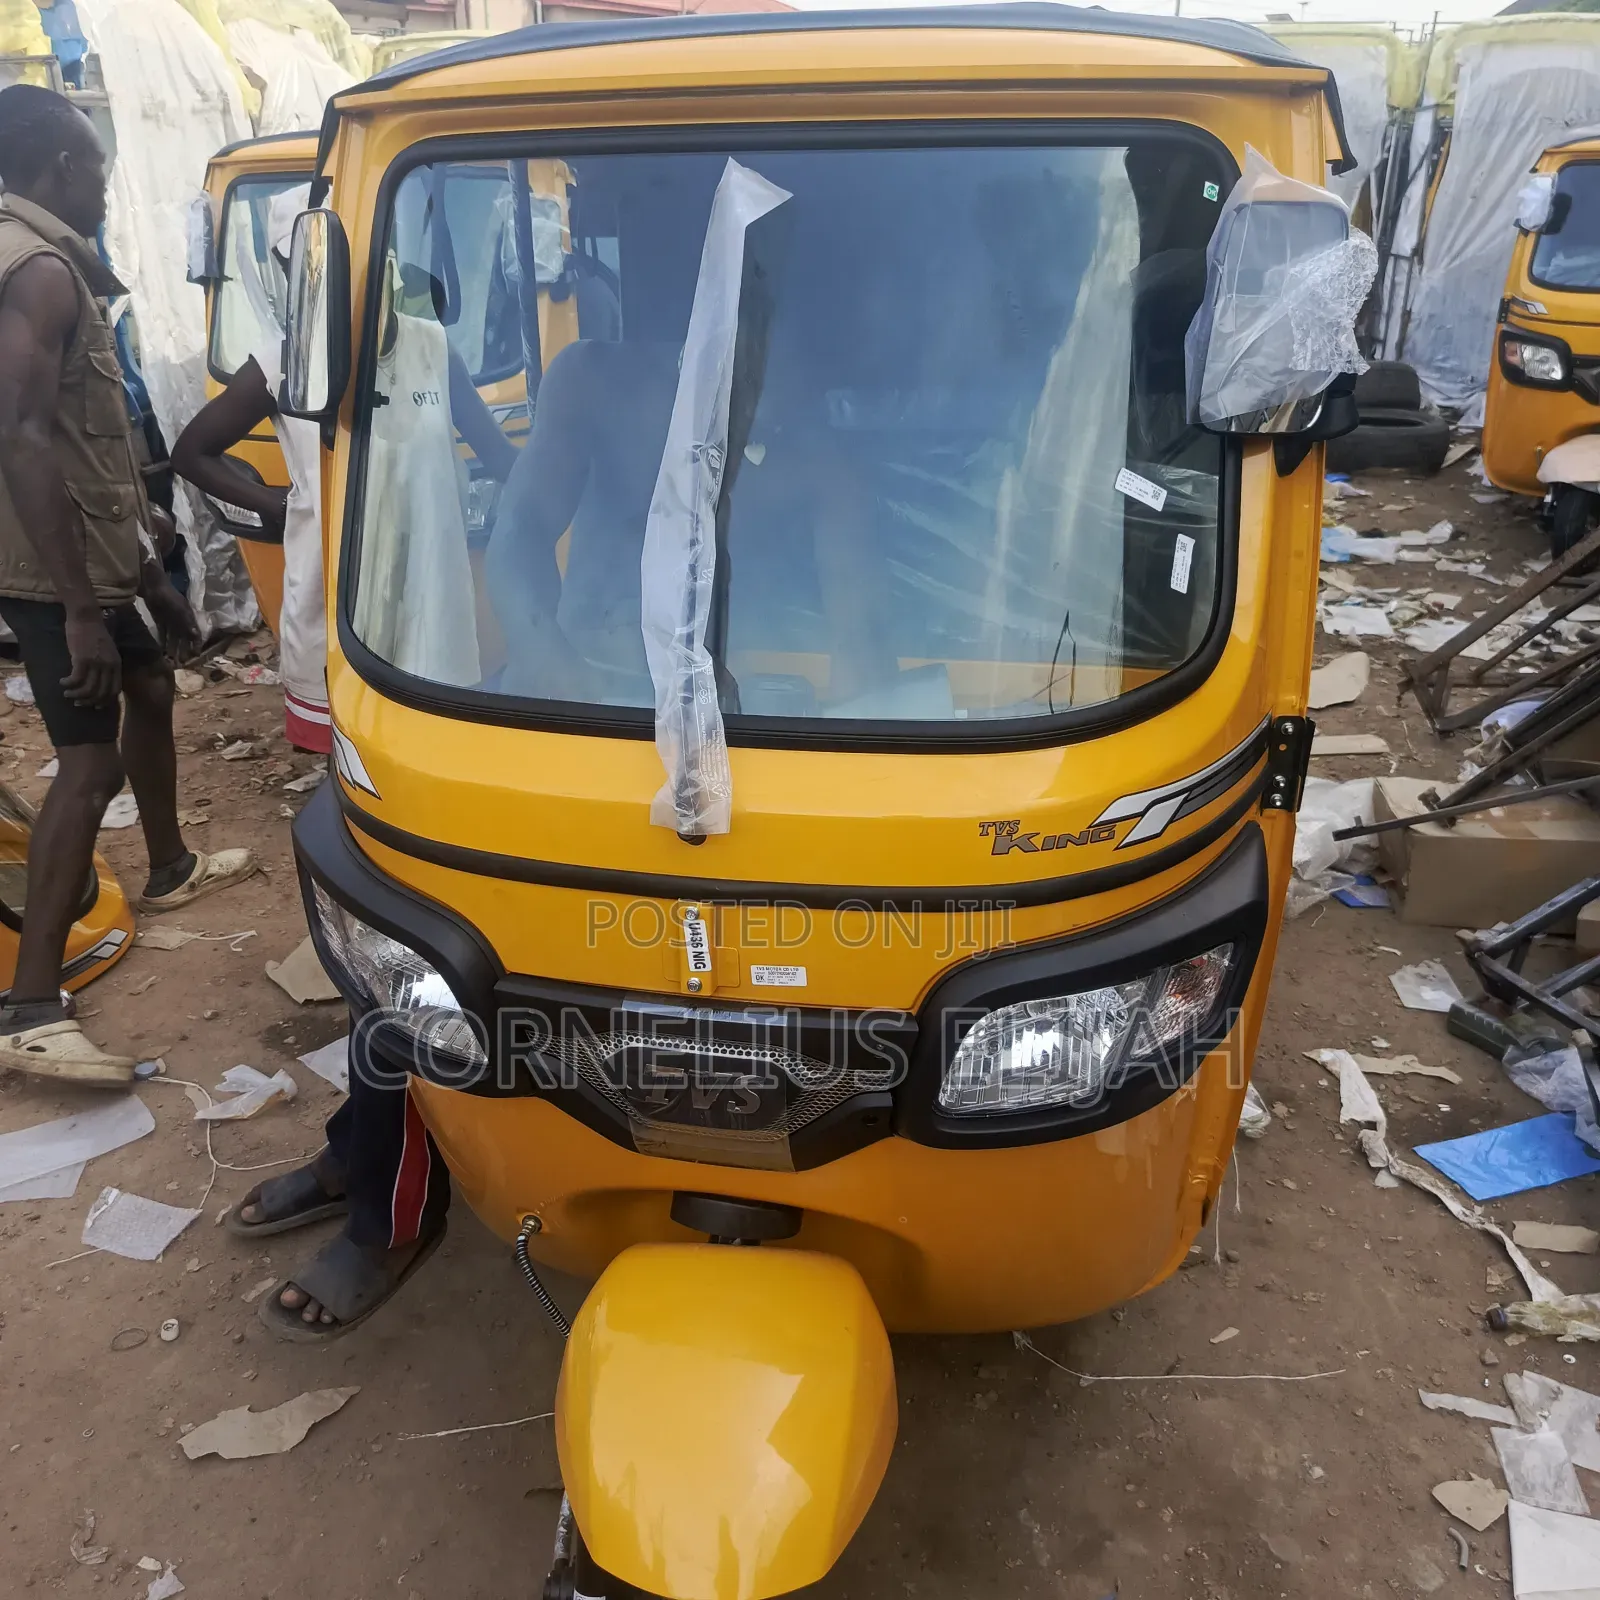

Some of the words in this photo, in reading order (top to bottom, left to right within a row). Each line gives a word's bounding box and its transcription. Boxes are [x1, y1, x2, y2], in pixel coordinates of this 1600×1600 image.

[979, 820, 1020, 836] TVS
[692, 951, 707, 970] NIG
[644, 1063, 767, 1115] TVS
